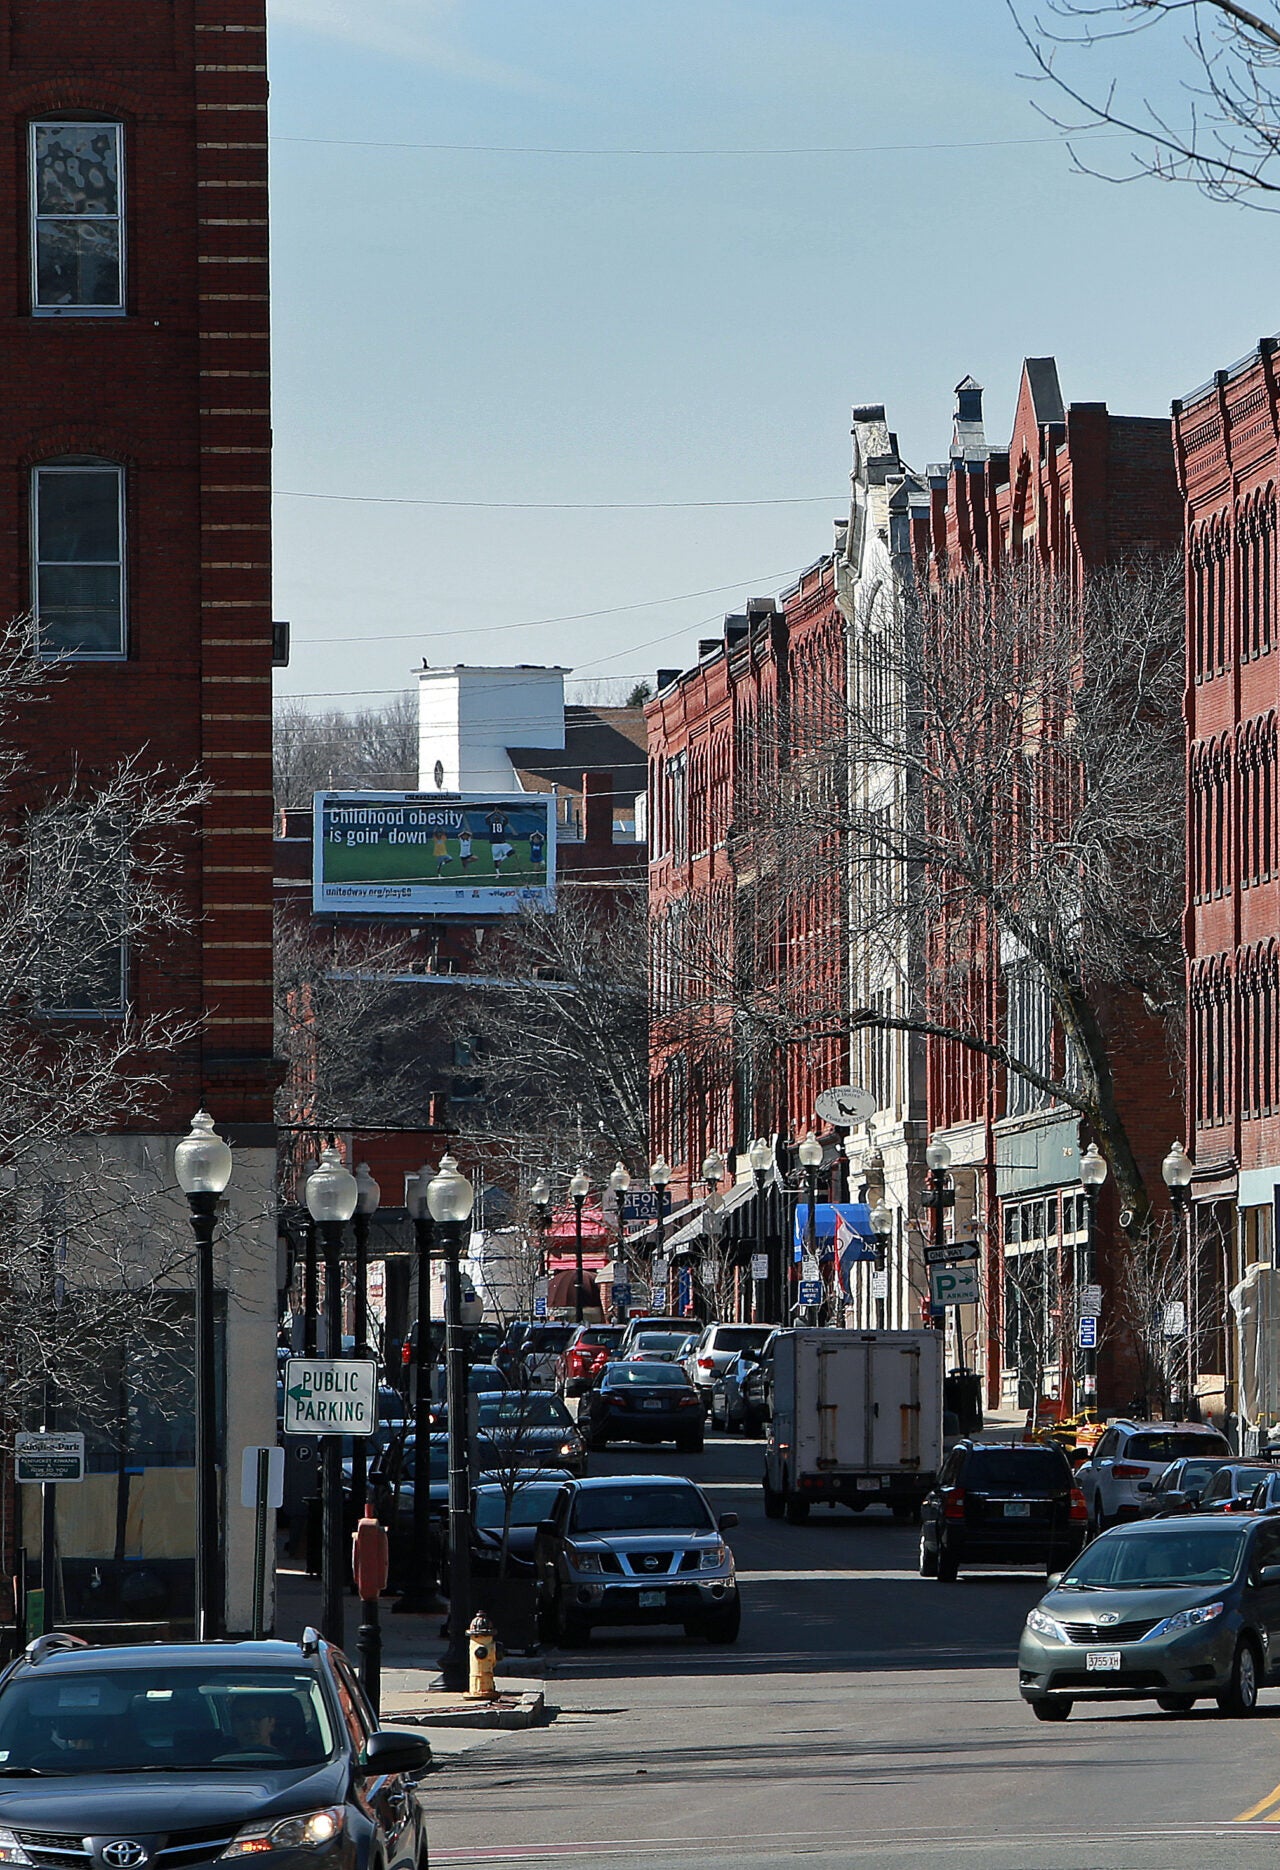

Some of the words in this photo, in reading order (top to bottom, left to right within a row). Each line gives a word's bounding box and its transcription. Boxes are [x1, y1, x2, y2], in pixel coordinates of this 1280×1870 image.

[329, 807, 404, 825] Childhood
[409, 809, 463, 828] obesity
[329, 827, 342, 843] is
[347, 827, 383, 847] goin'
[388, 828, 427, 844] down
[492, 823, 503, 833] 18
[302, 1371, 359, 1392] PUBLIC
[295, 1401, 364, 1422] PARKING
[1088, 1656, 1108, 1667] 3755
[1109, 1656, 1119, 1666] XH
